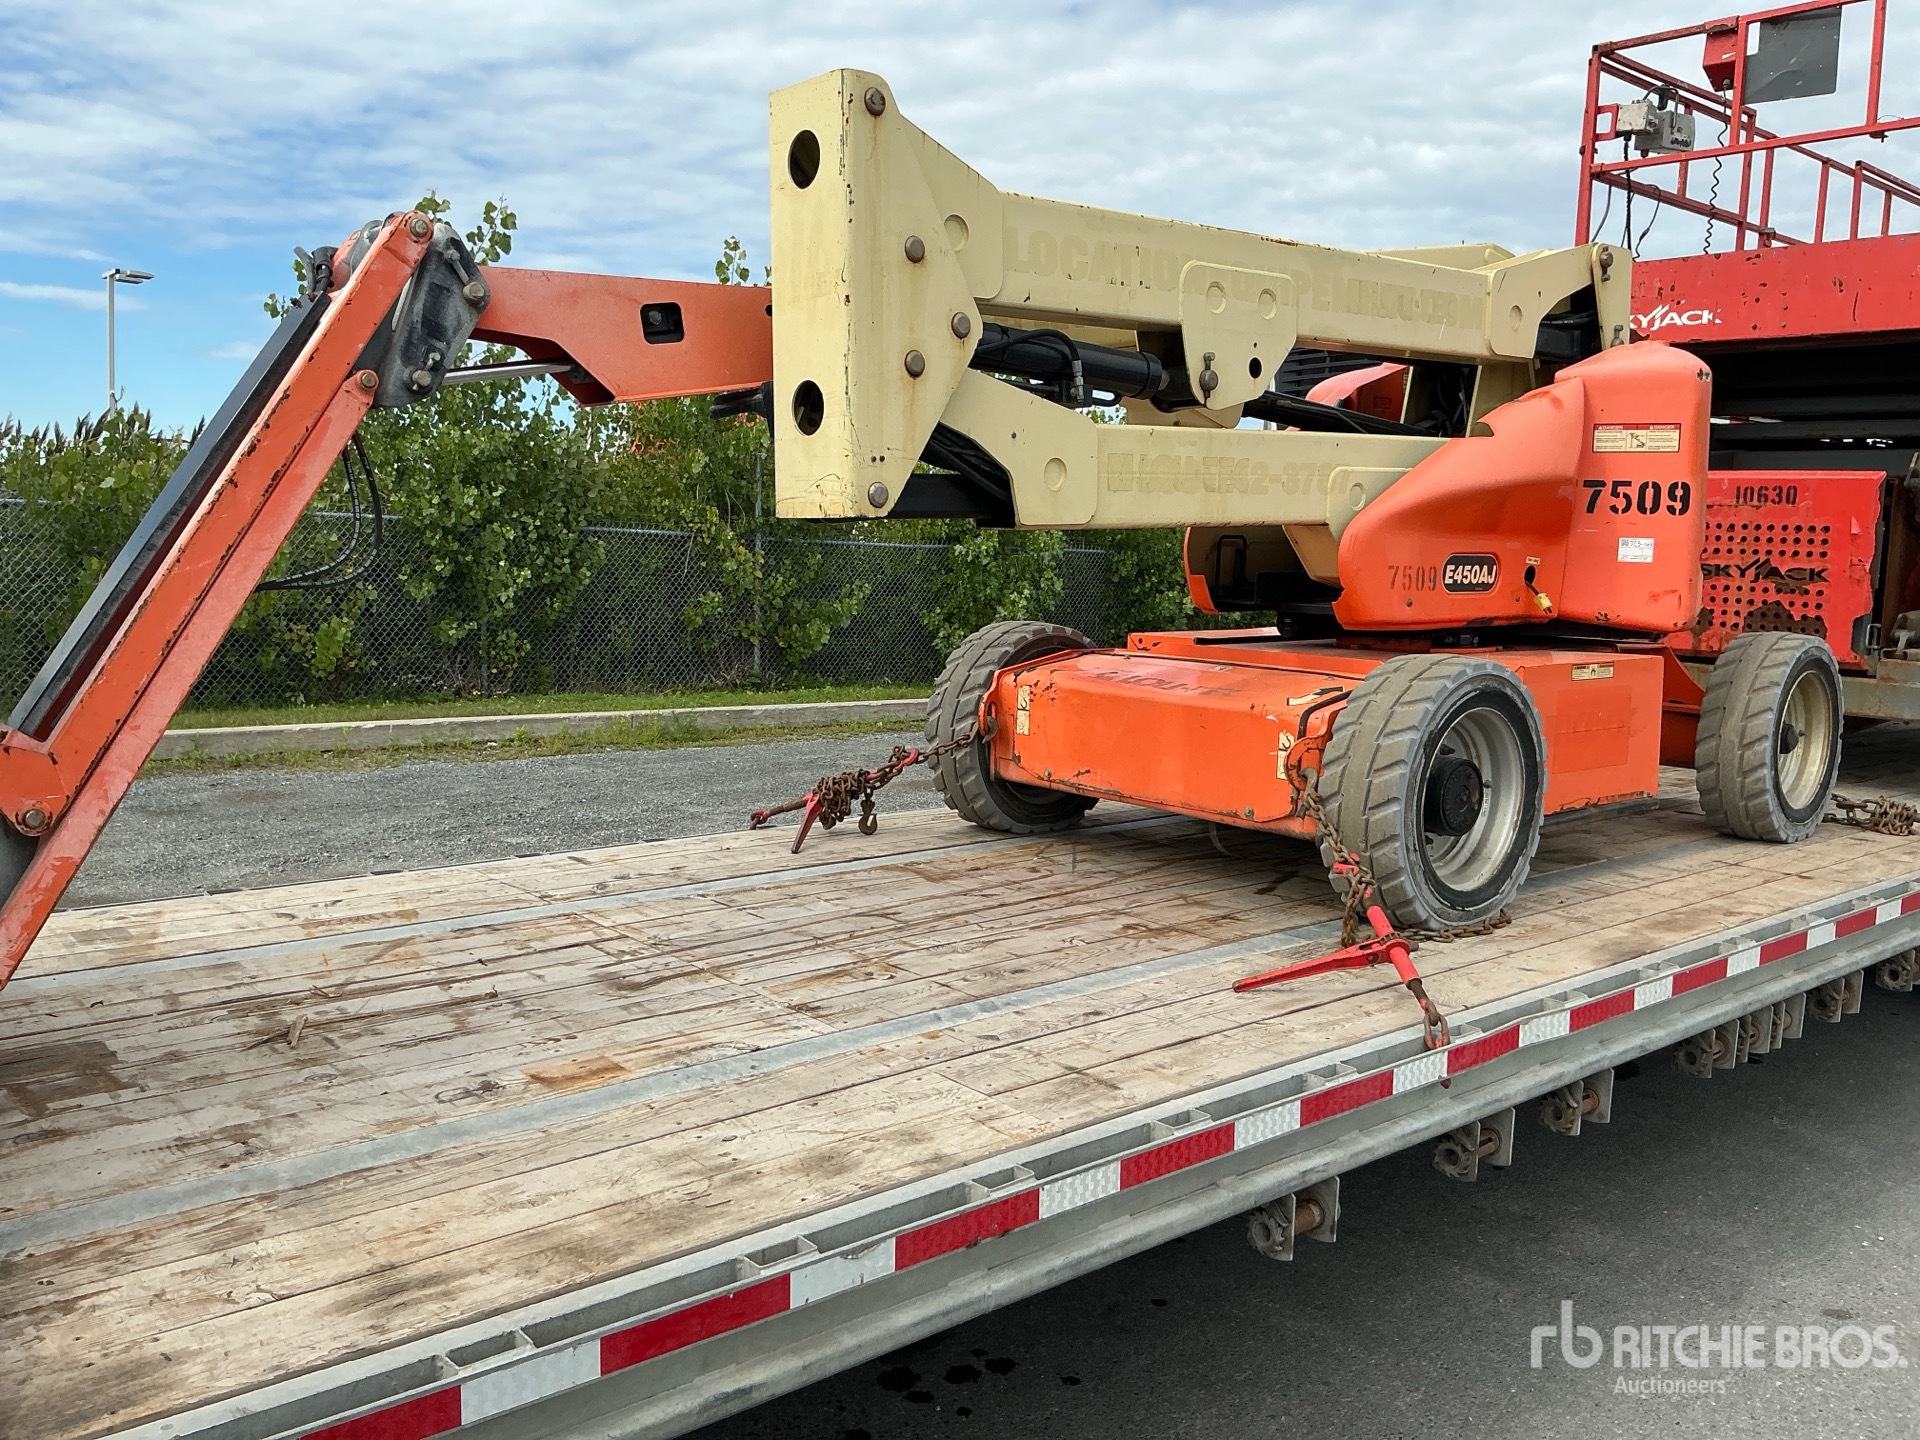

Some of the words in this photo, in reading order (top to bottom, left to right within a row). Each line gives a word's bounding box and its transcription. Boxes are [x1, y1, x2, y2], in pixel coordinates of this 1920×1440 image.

[1630, 304, 1722, 331] KYJACK
[1583, 480, 1691, 516] 7509
[1735, 485, 1798, 506] 10630
[1388, 565, 1437, 592] 7509
[1444, 564, 1497, 584] E450AJ
[1700, 557, 1830, 583] SKYJACK
